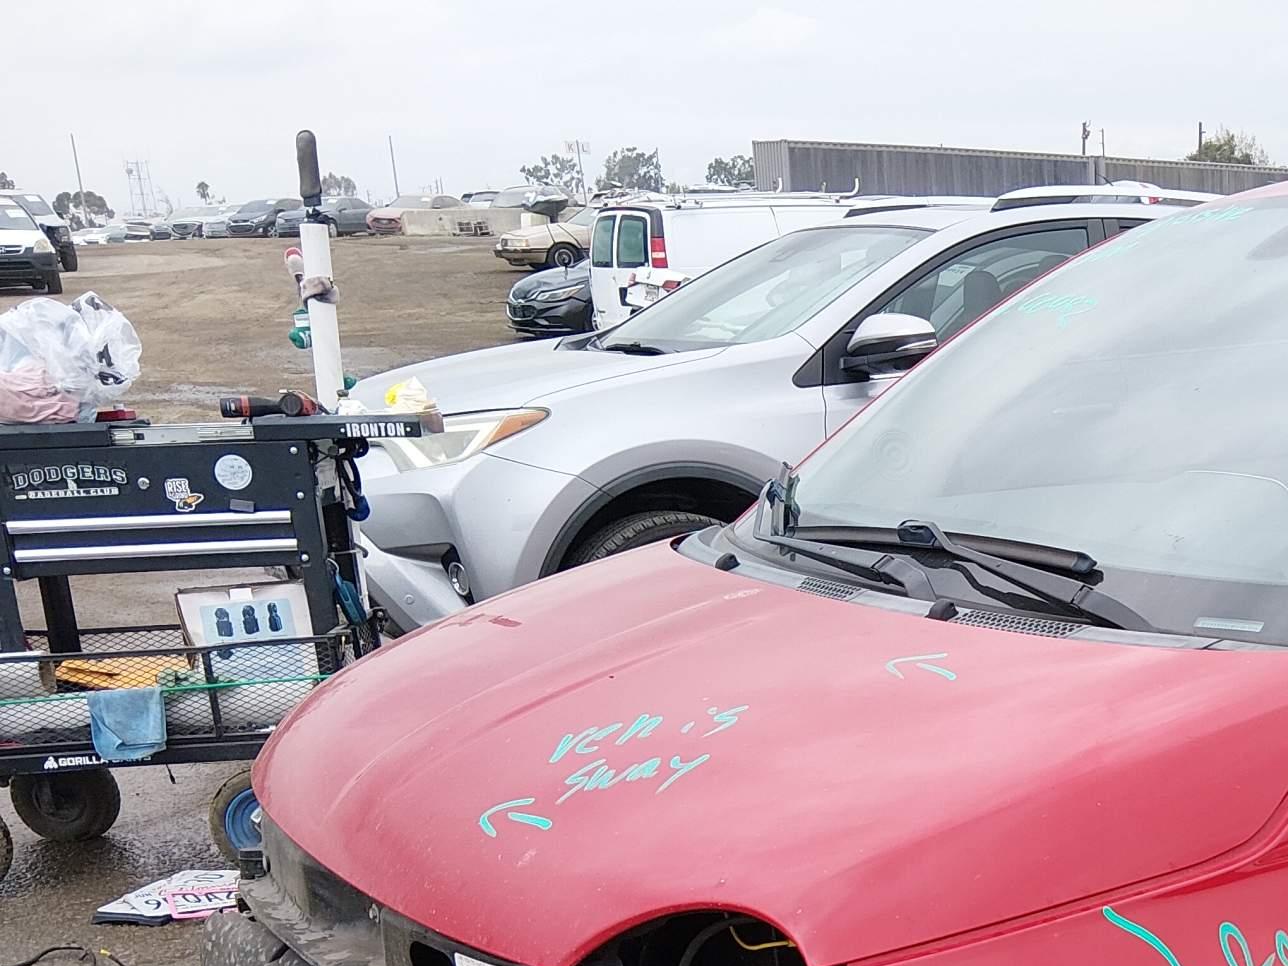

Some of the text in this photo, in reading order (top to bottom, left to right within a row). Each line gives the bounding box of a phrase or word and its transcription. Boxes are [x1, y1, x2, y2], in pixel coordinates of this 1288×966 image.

[345, 422, 405, 437] IRONTON
[12, 464, 128, 490] DODGERS
[167, 480, 187, 492] RISE
[58, 755, 108, 767] GORILLA
